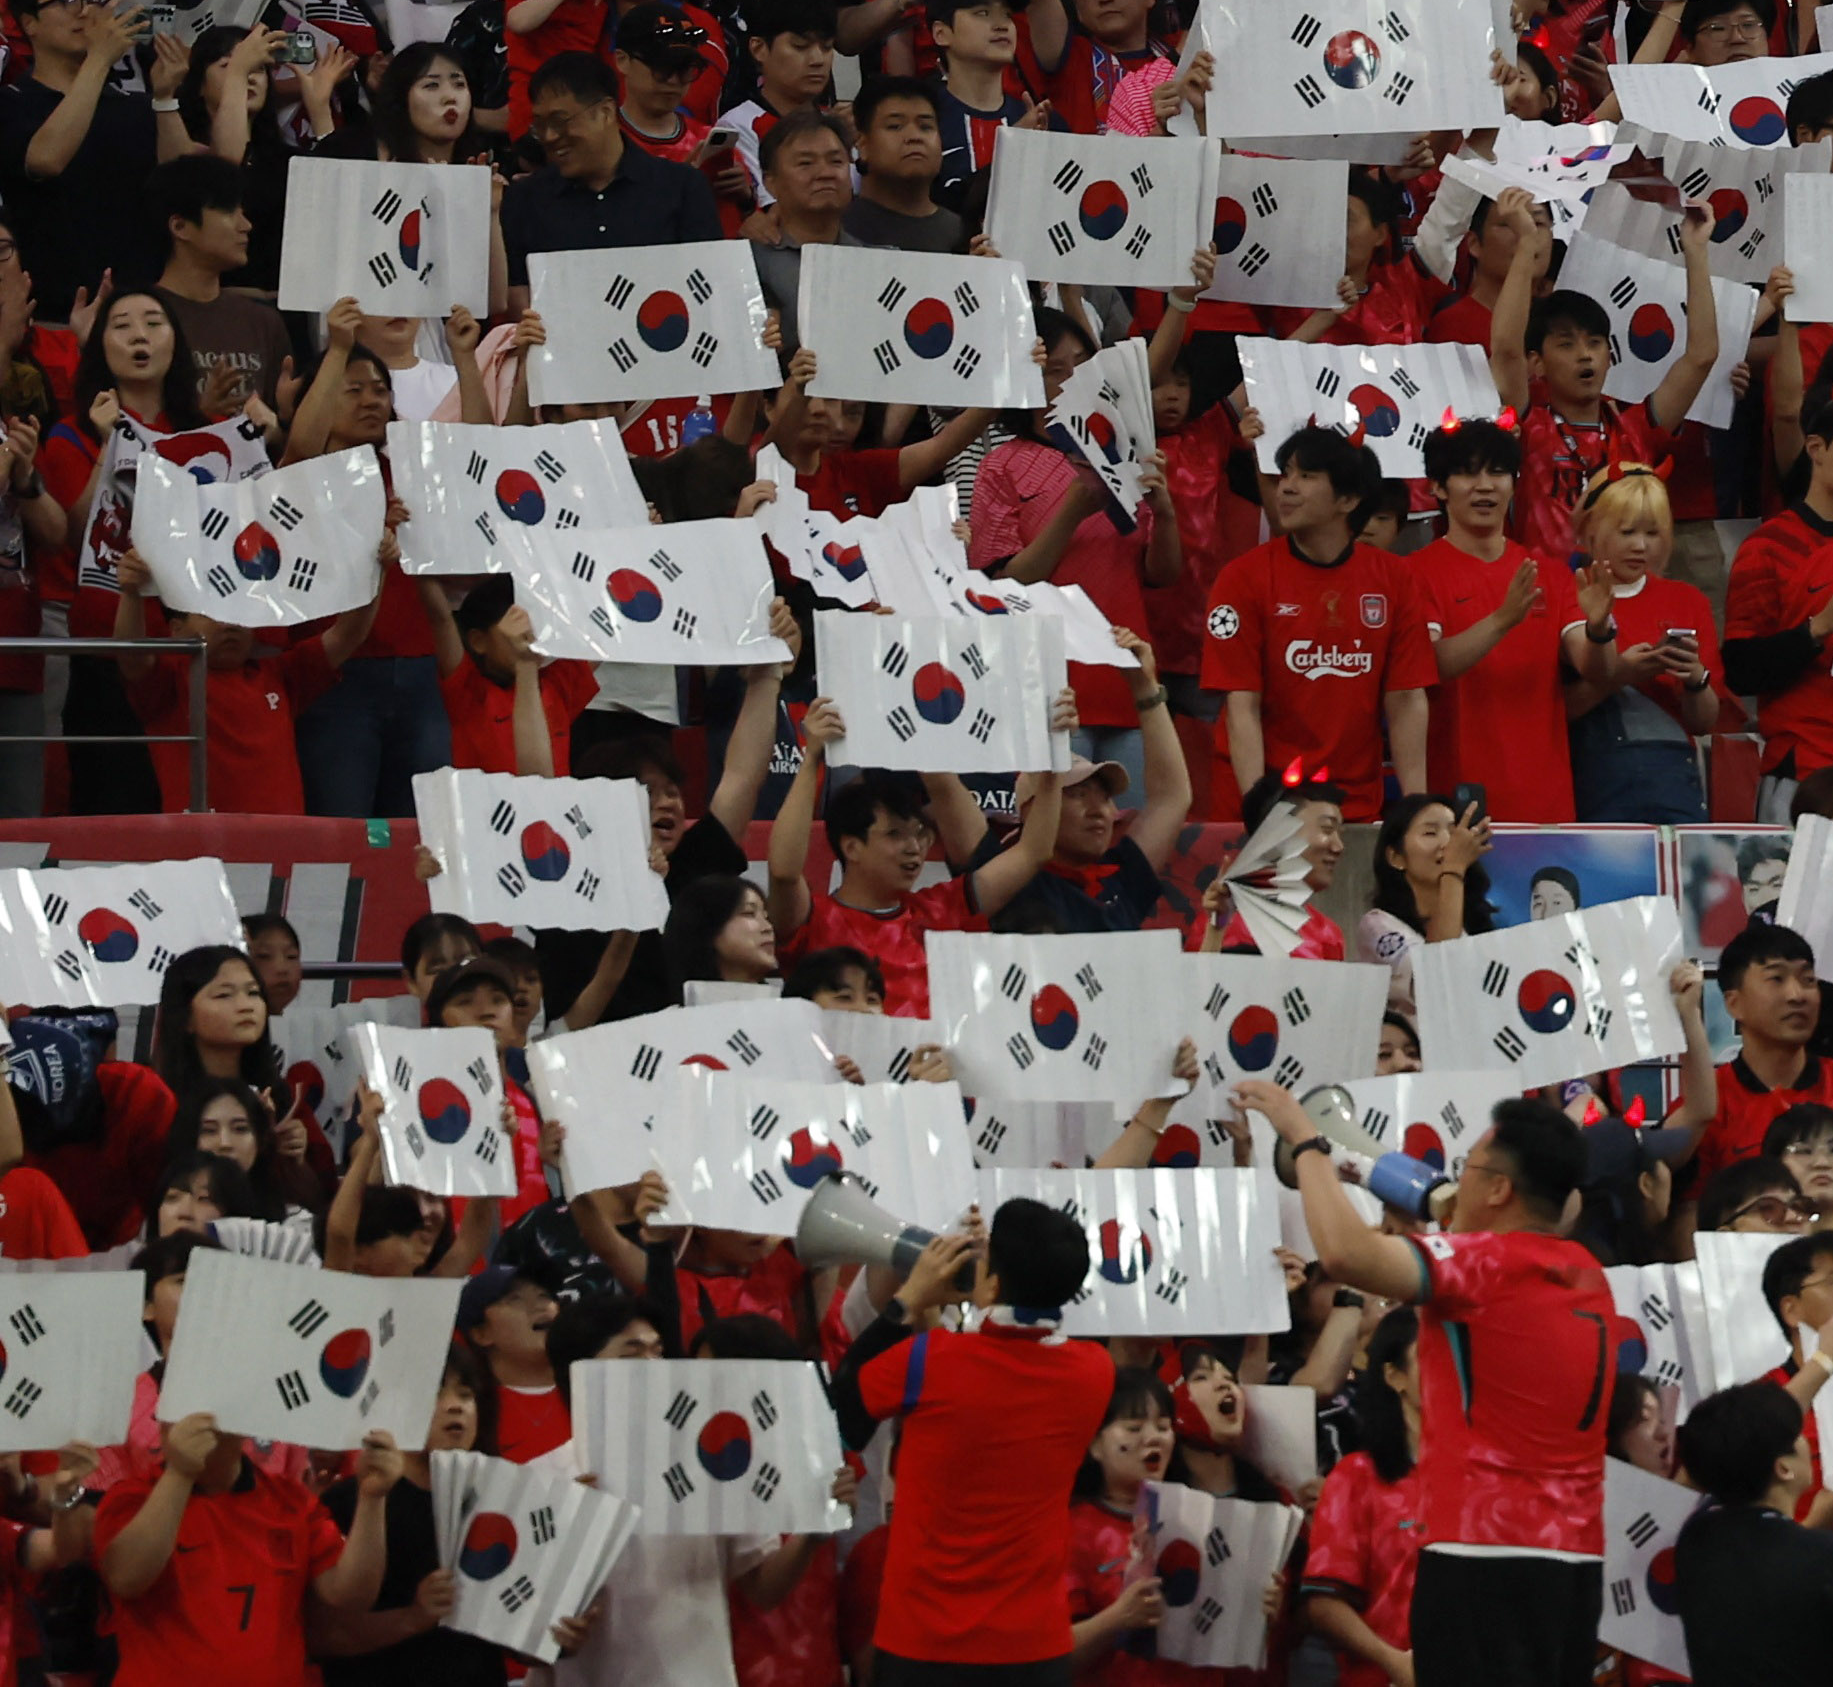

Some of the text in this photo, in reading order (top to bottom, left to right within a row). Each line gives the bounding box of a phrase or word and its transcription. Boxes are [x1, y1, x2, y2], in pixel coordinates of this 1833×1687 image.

[1285, 639, 1373, 678] Carlsberg
[45, 1043, 66, 1104] KOREA
[225, 1584, 257, 1634] 7
